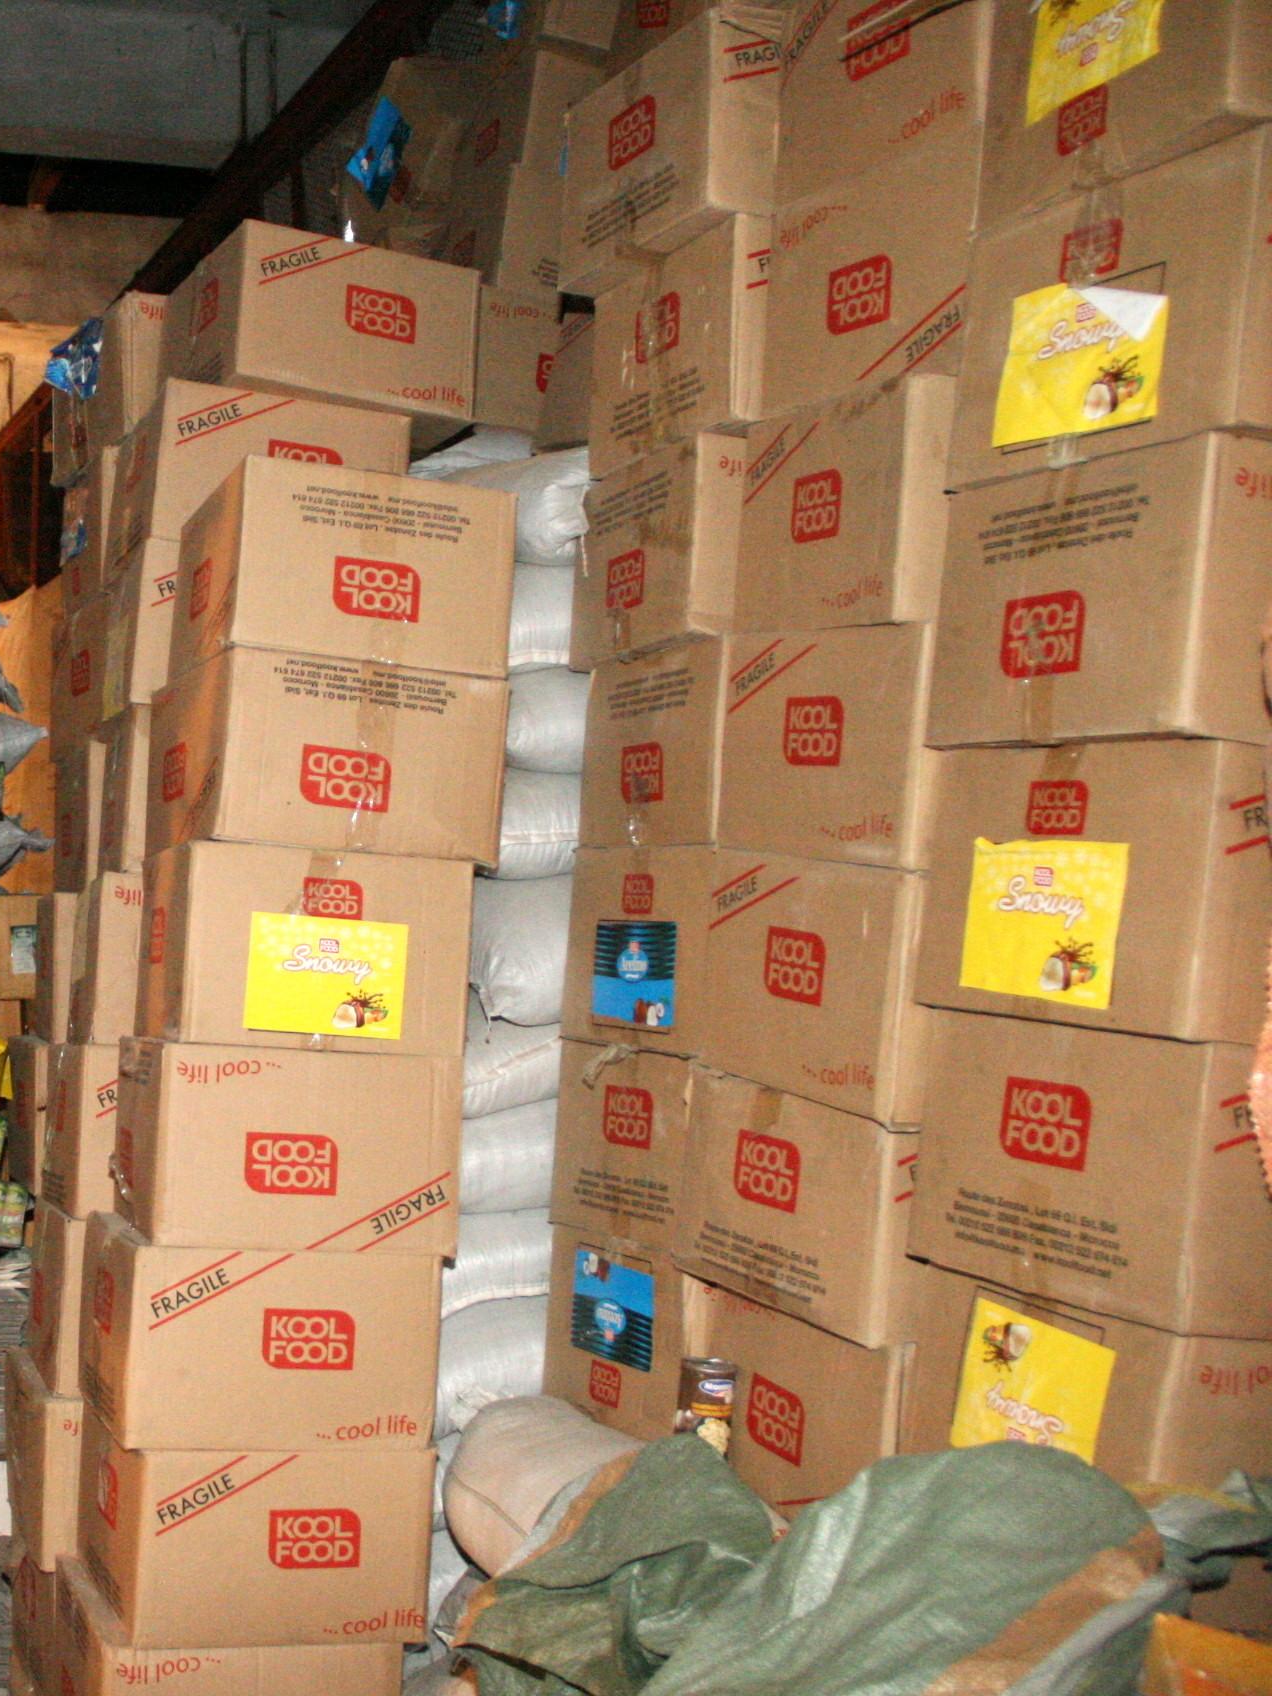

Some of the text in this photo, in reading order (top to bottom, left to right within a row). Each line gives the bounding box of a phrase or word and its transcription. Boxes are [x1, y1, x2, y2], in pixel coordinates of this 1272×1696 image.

[612, 104, 651, 146] KOOL
[260, 246, 322, 277] FRAGILE
[833, 263, 888, 301] FOOD
[351, 290, 411, 319] KOOL
[832, 290, 886, 326] KOOL
[350, 311, 411, 338] FOOD
[904, 302, 962, 363] FRAGILE
[1040, 319, 1128, 359] Snowy
[441, 386, 466, 407] life
[177, 403, 243, 437] FRAGILE
[797, 479, 838, 512] KOOL
[795, 505, 838, 537] FOOD
[340, 563, 415, 593] FOOD
[339, 586, 414, 615] KOOL
[735, 652, 776, 696] FRAGILE
[790, 704, 838, 730] KOOL
[787, 733, 837, 757] FOOD
[306, 751, 385, 781] FOOD
[306, 774, 384, 807] KOOL
[1034, 787, 1083, 807] KOOL
[1031, 808, 1081, 829] FOOD
[115, 885, 142, 906] life
[308, 882, 359, 899] KOOL
[717, 875, 758, 912] FRAGILE
[998, 876, 1084, 929] Snowy
[307, 899, 360, 916] FOOD
[282, 943, 373, 986] Snowy
[771, 935, 819, 969] KOOL
[768, 963, 819, 995] FOOD
[177, 1061, 209, 1084] life
[608, 1094, 649, 1118] KOOL
[1009, 1087, 1083, 1128] KOOL
[607, 1118, 648, 1141] FOOD
[1005, 1120, 1081, 1159] FOOD
[252, 1139, 332, 1164] FOOD
[742, 1138, 793, 1176] KOOL
[252, 1164, 331, 1189] KOOL
[739, 1165, 793, 1202] FOOD
[370, 1184, 447, 1236] FRAGILE
[150, 1268, 230, 1319] FRAGILE
[270, 1316, 348, 1340] KOOL
[268, 1341, 348, 1364] FOOD
[755, 1386, 802, 1429] FOOD
[985, 1381, 1065, 1446] Snowy
[316, 1414, 418, 1441] ...cool life
[751, 1407, 799, 1457] KOOL
[156, 1473, 236, 1526] FRAGILE
[276, 1515, 355, 1539] KOOL
[274, 1539, 355, 1563] FOOD
[322, 1607, 426, 1636] ...cool life
[116, 1663, 149, 1685] life
